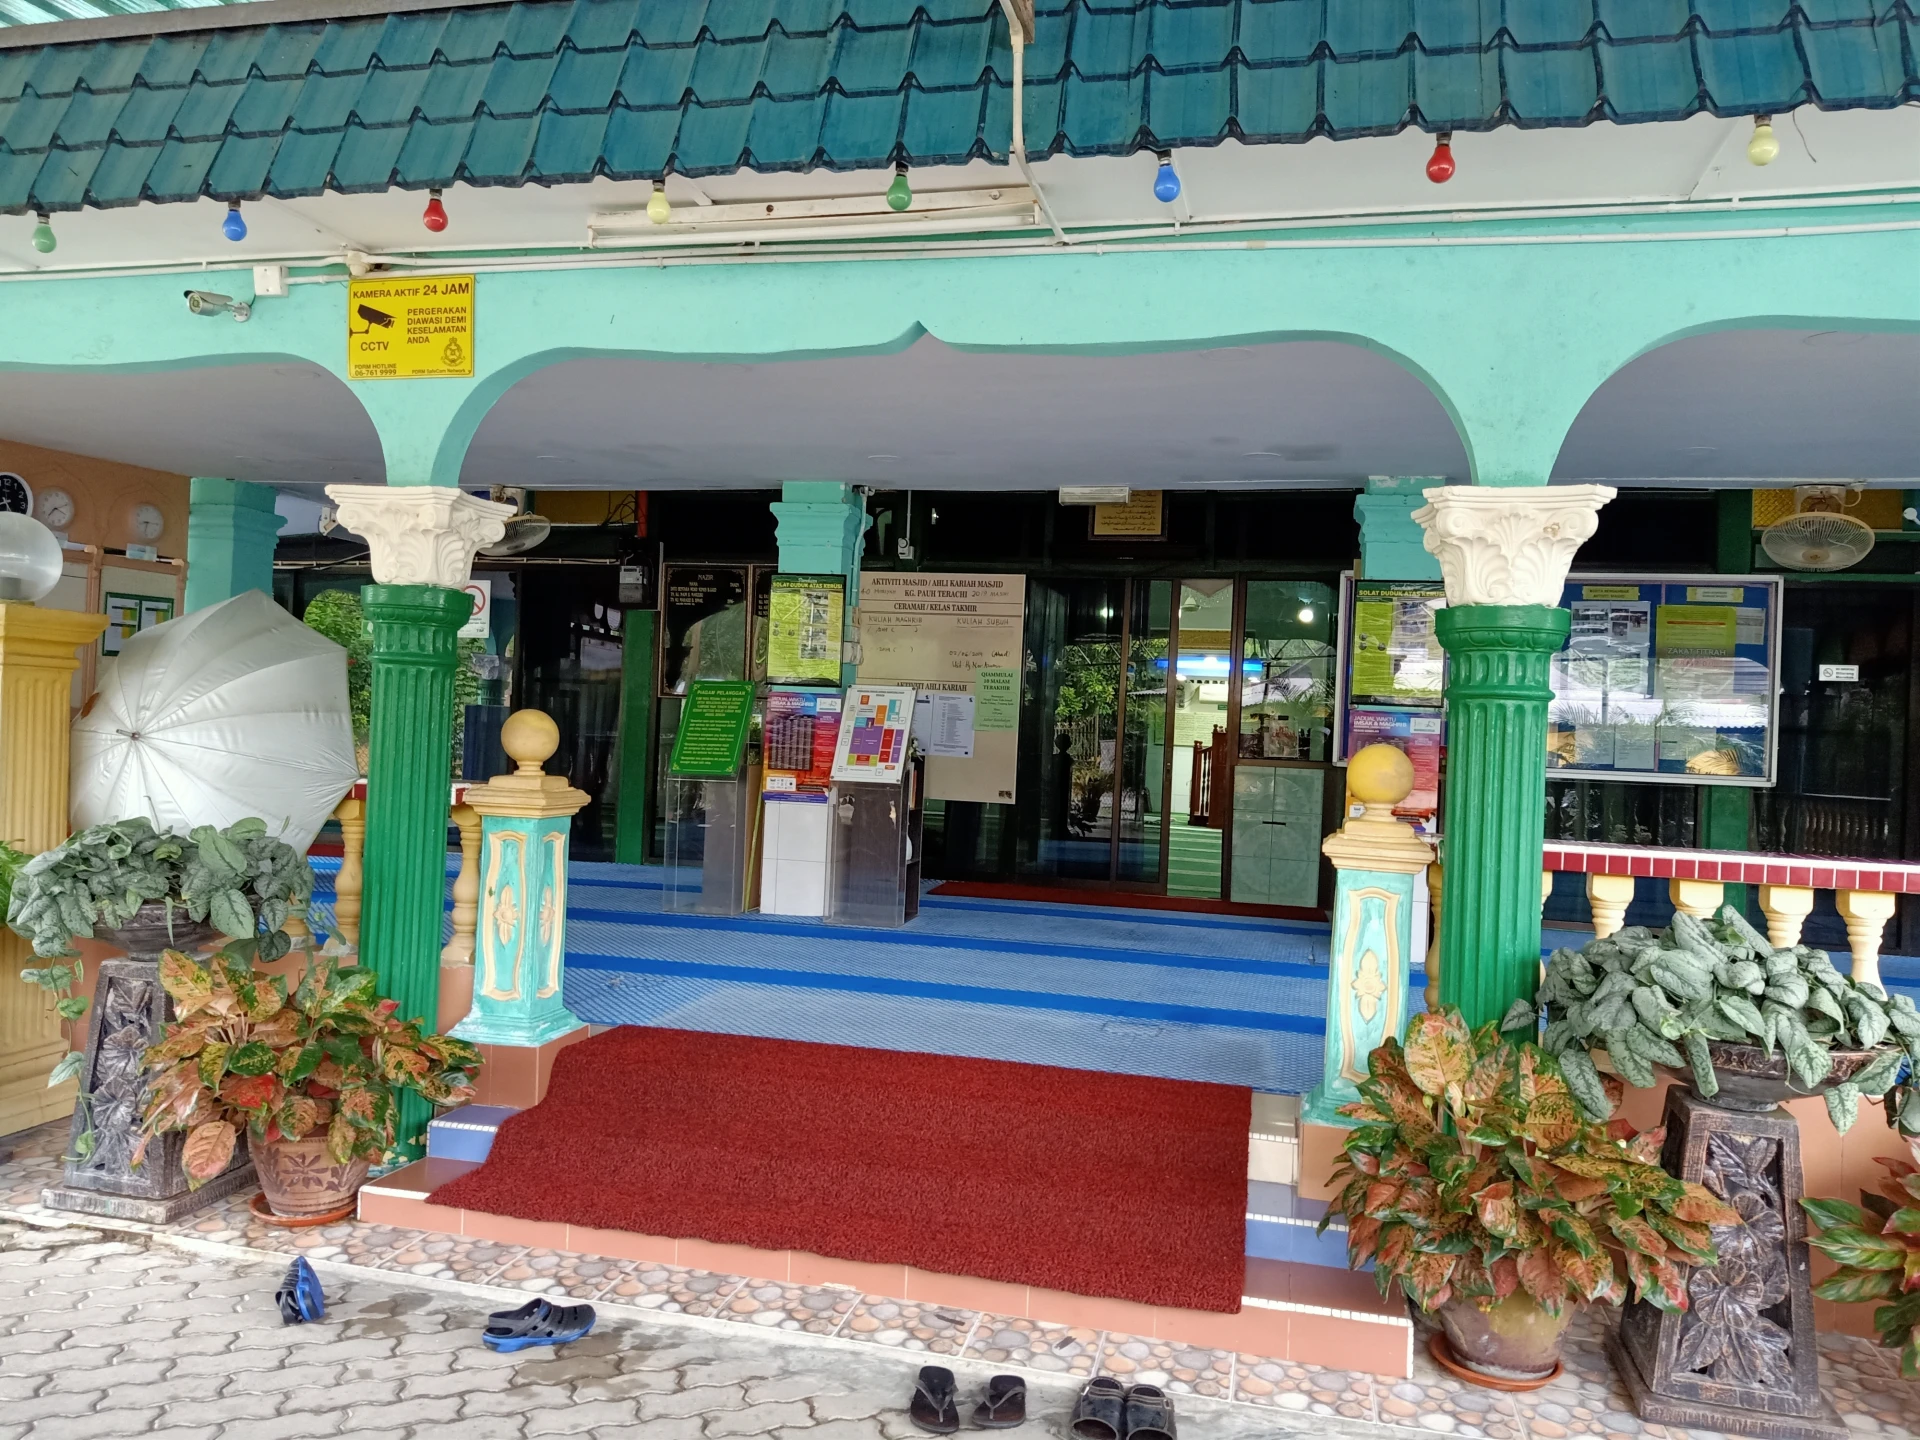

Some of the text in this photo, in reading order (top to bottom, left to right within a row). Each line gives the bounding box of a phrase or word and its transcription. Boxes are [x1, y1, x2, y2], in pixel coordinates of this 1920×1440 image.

[353, 282, 470, 299] KAMERA AKTIF 24 JAM
[407, 306, 466, 316] PERGERAKAN
[407, 316, 442, 325] DIAWASI
[407, 326, 466, 334] KESELAMATAN
[360, 341, 389, 352] CCTV
